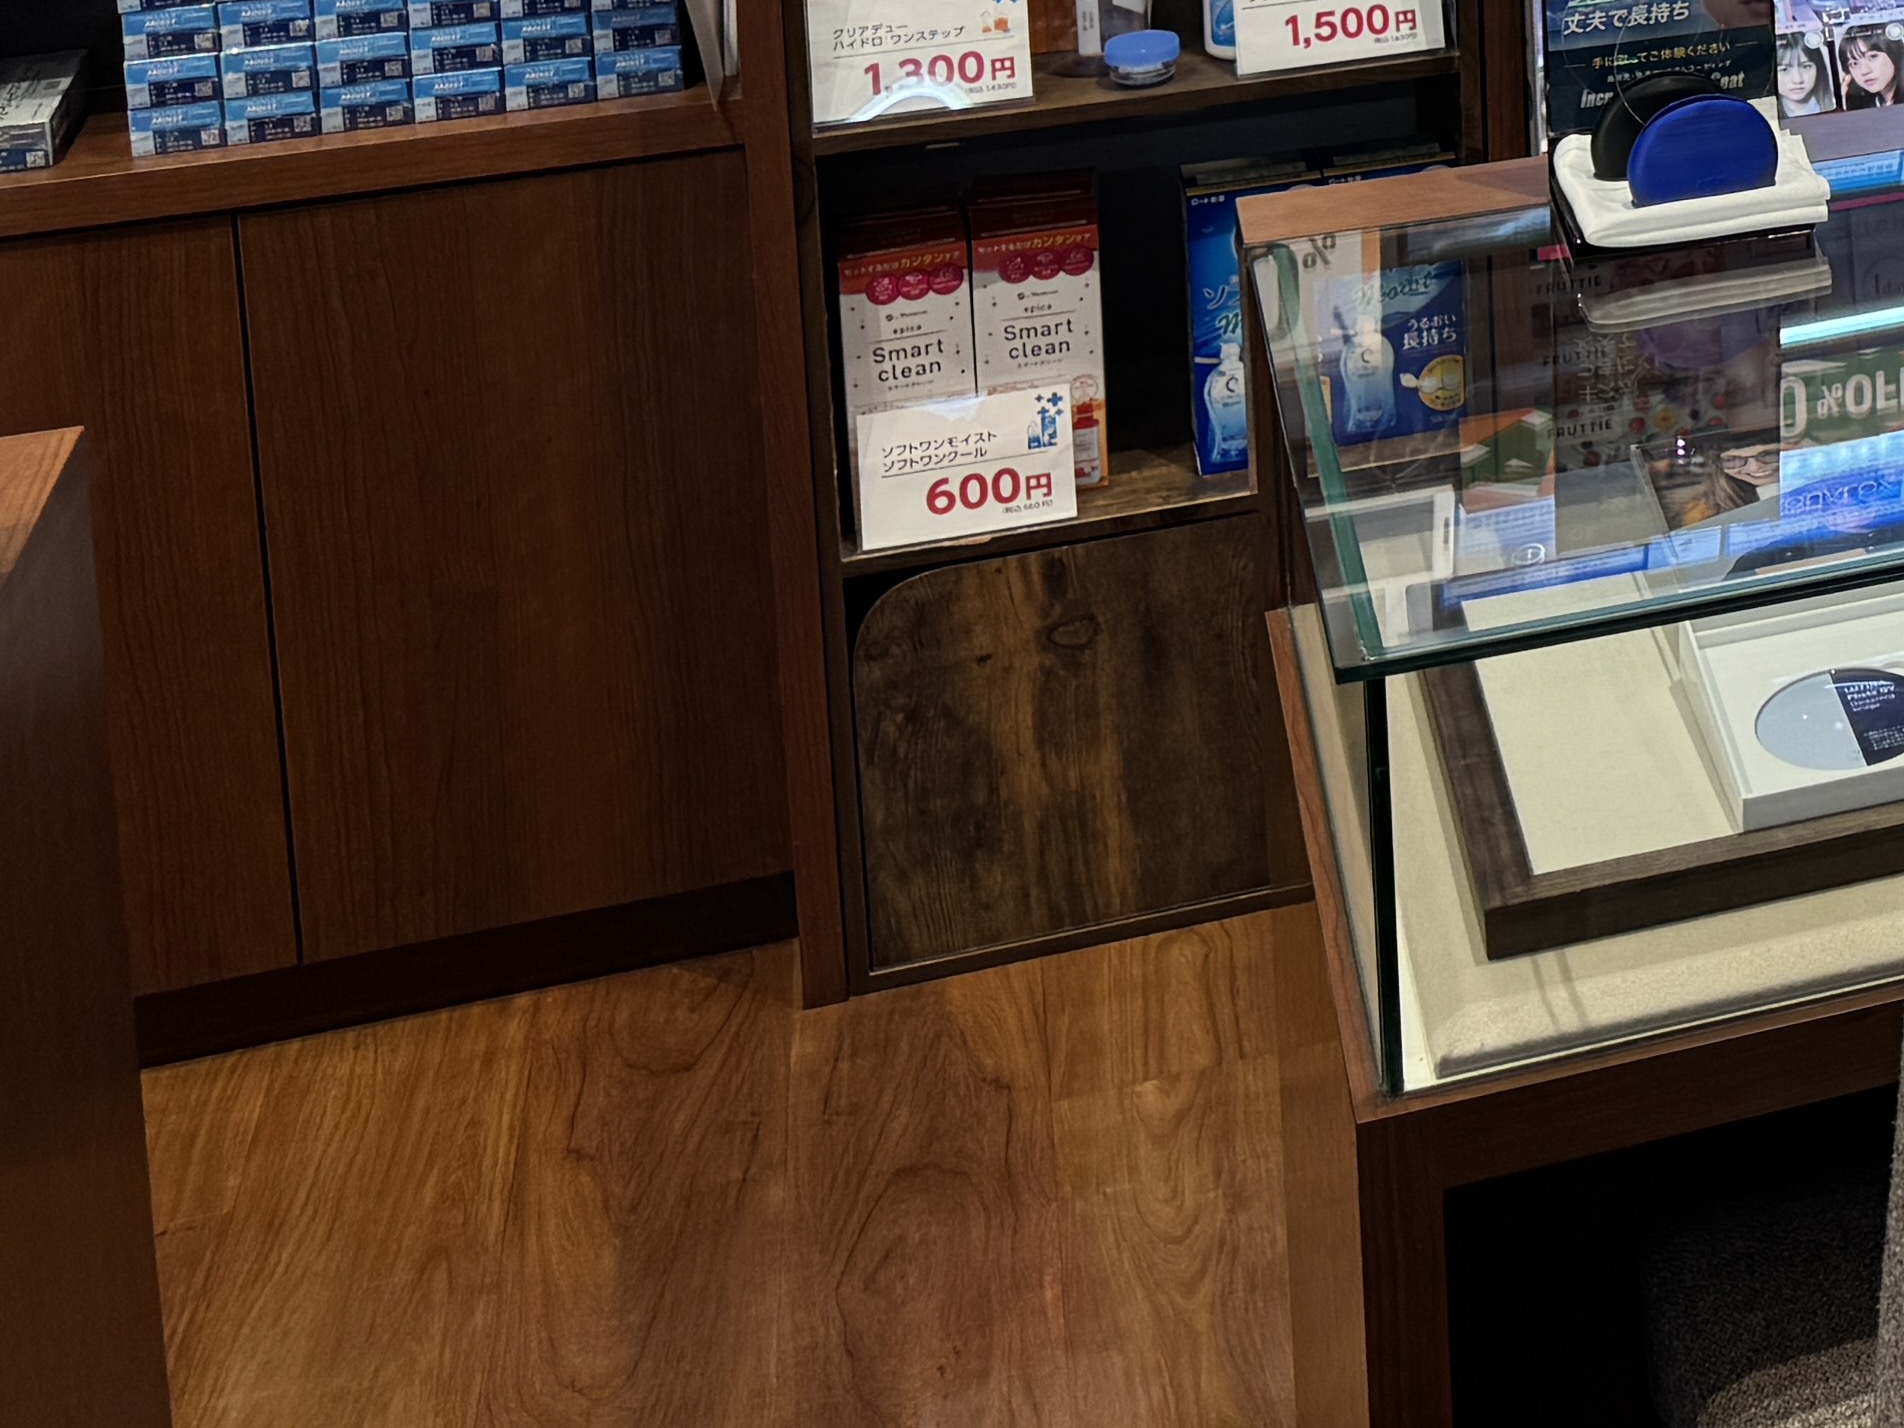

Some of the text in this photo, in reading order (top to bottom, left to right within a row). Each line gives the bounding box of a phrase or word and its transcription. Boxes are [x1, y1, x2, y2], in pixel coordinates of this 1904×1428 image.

[1284, 3, 1417, 50] 1,500円
[1563, 0, 1691, 36] 丈夫で長持ち
[832, 23, 909, 41] クリアデュー
[1003, 318, 1074, 342] Smart
[1402, 329, 1457, 351] 長持ち
[872, 338, 944, 364] Smart
[1008, 339, 1071, 361] clean
[877, 358, 942, 383] clean
[881, 431, 998, 459] ソフトワンモイスト
[882, 446, 988, 473] ソフトワンクール
[925, 466, 1053, 516] 600円
